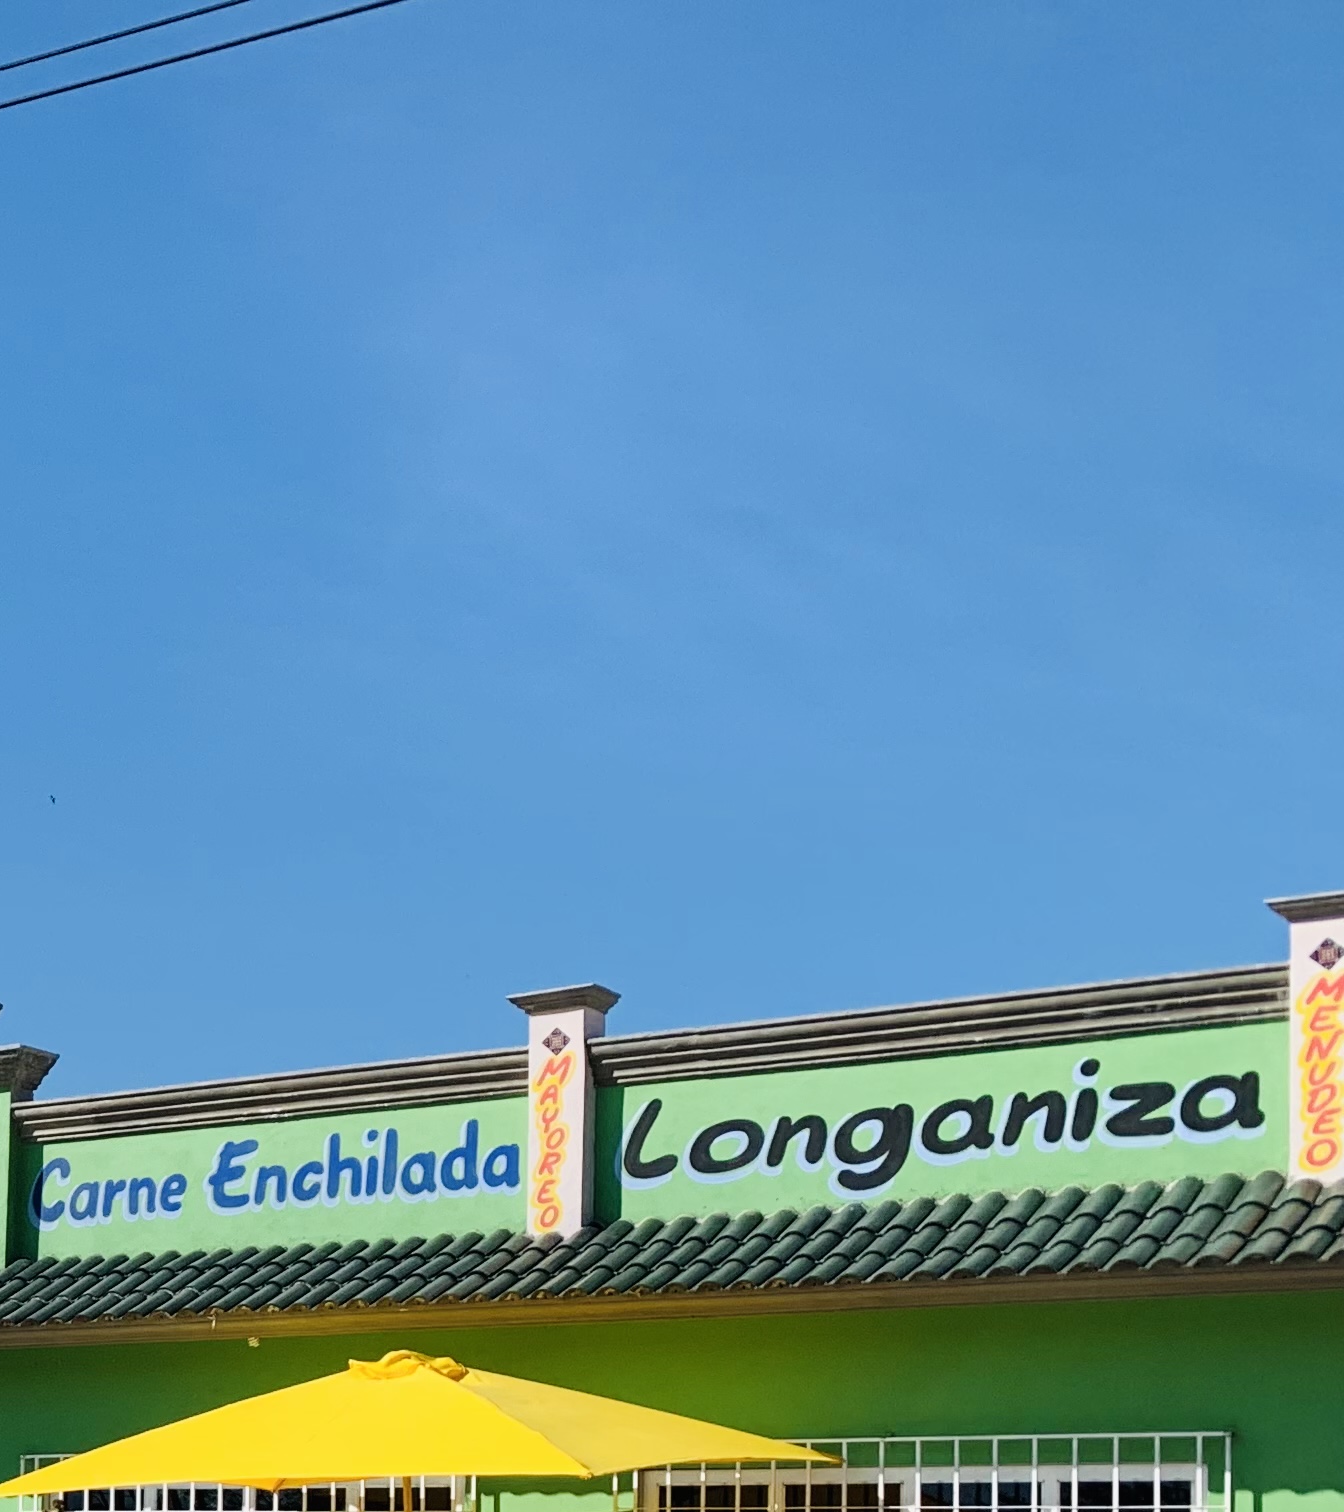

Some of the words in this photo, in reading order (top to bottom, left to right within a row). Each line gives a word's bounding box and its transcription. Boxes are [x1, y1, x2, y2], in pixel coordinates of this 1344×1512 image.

[536, 1054, 572, 1228] MAYOREO
[620, 1058, 1266, 1195] Longaniza
[1305, 974, 1344, 1167] MENUDEO
[30, 1157, 188, 1228] Carne
[208, 1118, 522, 1213] Enchilada
